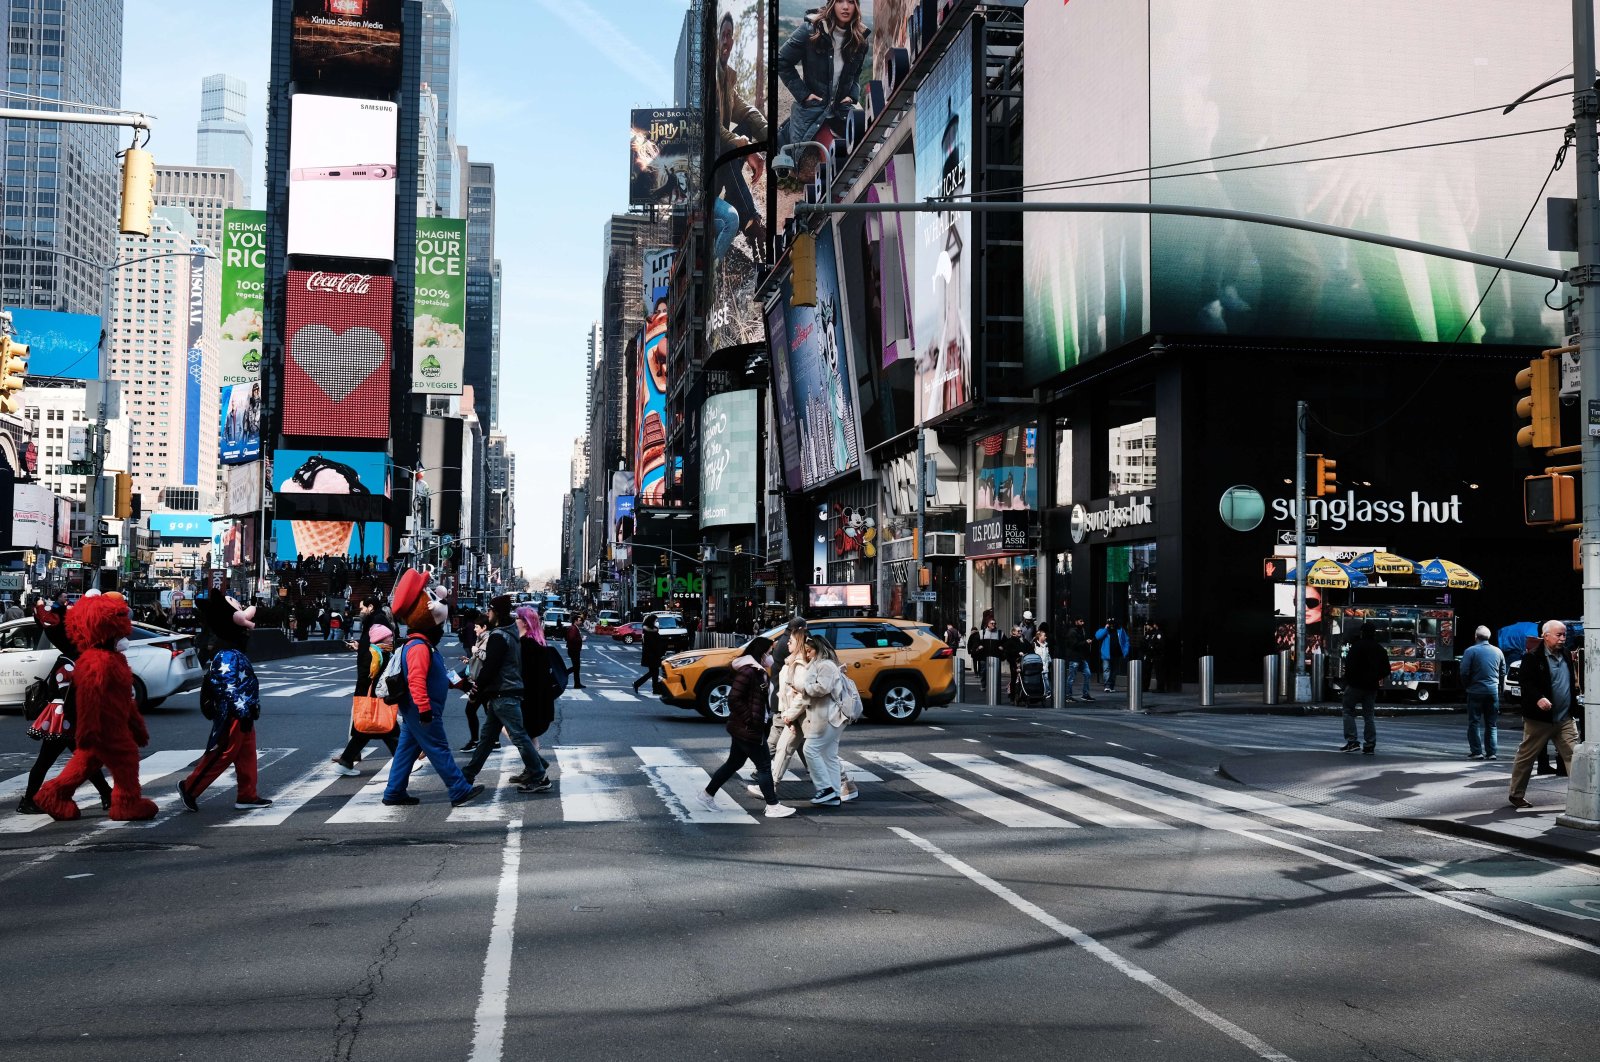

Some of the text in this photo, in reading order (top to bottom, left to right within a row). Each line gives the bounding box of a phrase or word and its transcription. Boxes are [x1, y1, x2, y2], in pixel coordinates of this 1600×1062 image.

[311, 16, 384, 29] Xinhua Screen Media
[360, 104, 393, 112] SAMSUNG
[649, 122, 678, 141] Harry
[306, 271, 373, 294] Coca-Cola
[414, 287, 450, 299] 100%
[66, 466, 73, 474] W
[77, 466, 85, 474] 45
[1411, 491, 1463, 523] hut
[1085, 496, 1153, 537] sunglass hut
[972, 522, 1000, 542] U.S. POLO
[0, 579, 18, 587] SKI
[1309, 577, 1347, 586] SABRETT
[1450, 579, 1478, 588] SABRETT
